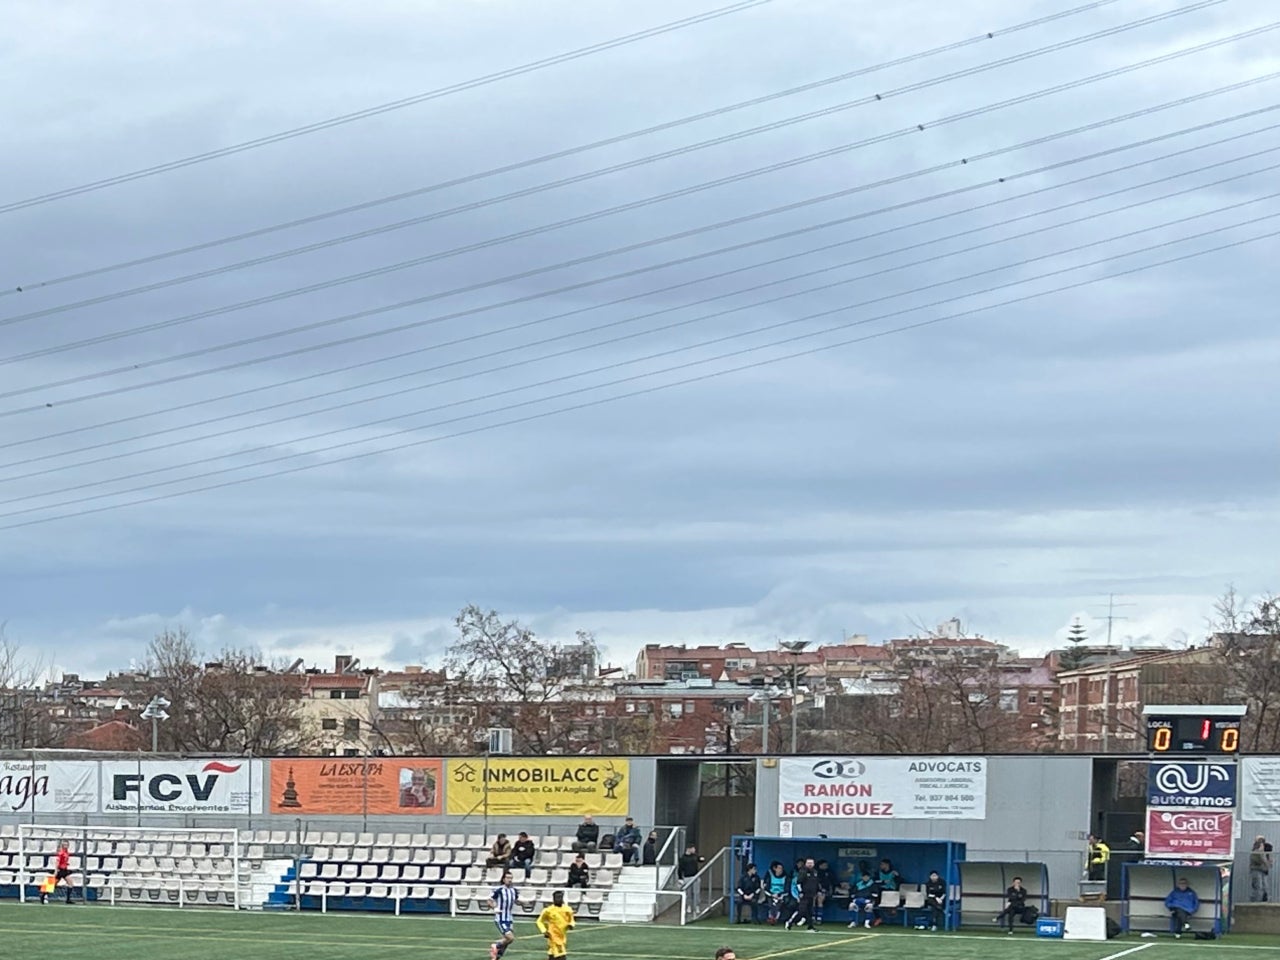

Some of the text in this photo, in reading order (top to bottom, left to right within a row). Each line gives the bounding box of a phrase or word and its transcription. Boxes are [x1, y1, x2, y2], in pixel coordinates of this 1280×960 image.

[1202, 719, 1211, 740] 1
[1154, 728, 1171, 751] 0
[1222, 728, 1238, 751] 0
[320, 764, 337, 776] LA
[908, 761, 982, 773] ADVOCATS
[482, 768, 599, 782] INMOBILACC
[113, 773, 219, 801] FCV
[804, 781, 873, 797] RAMÓN
[1150, 795, 1233, 806] autoramos
[783, 801, 894, 816] RODRÍGUEZ
